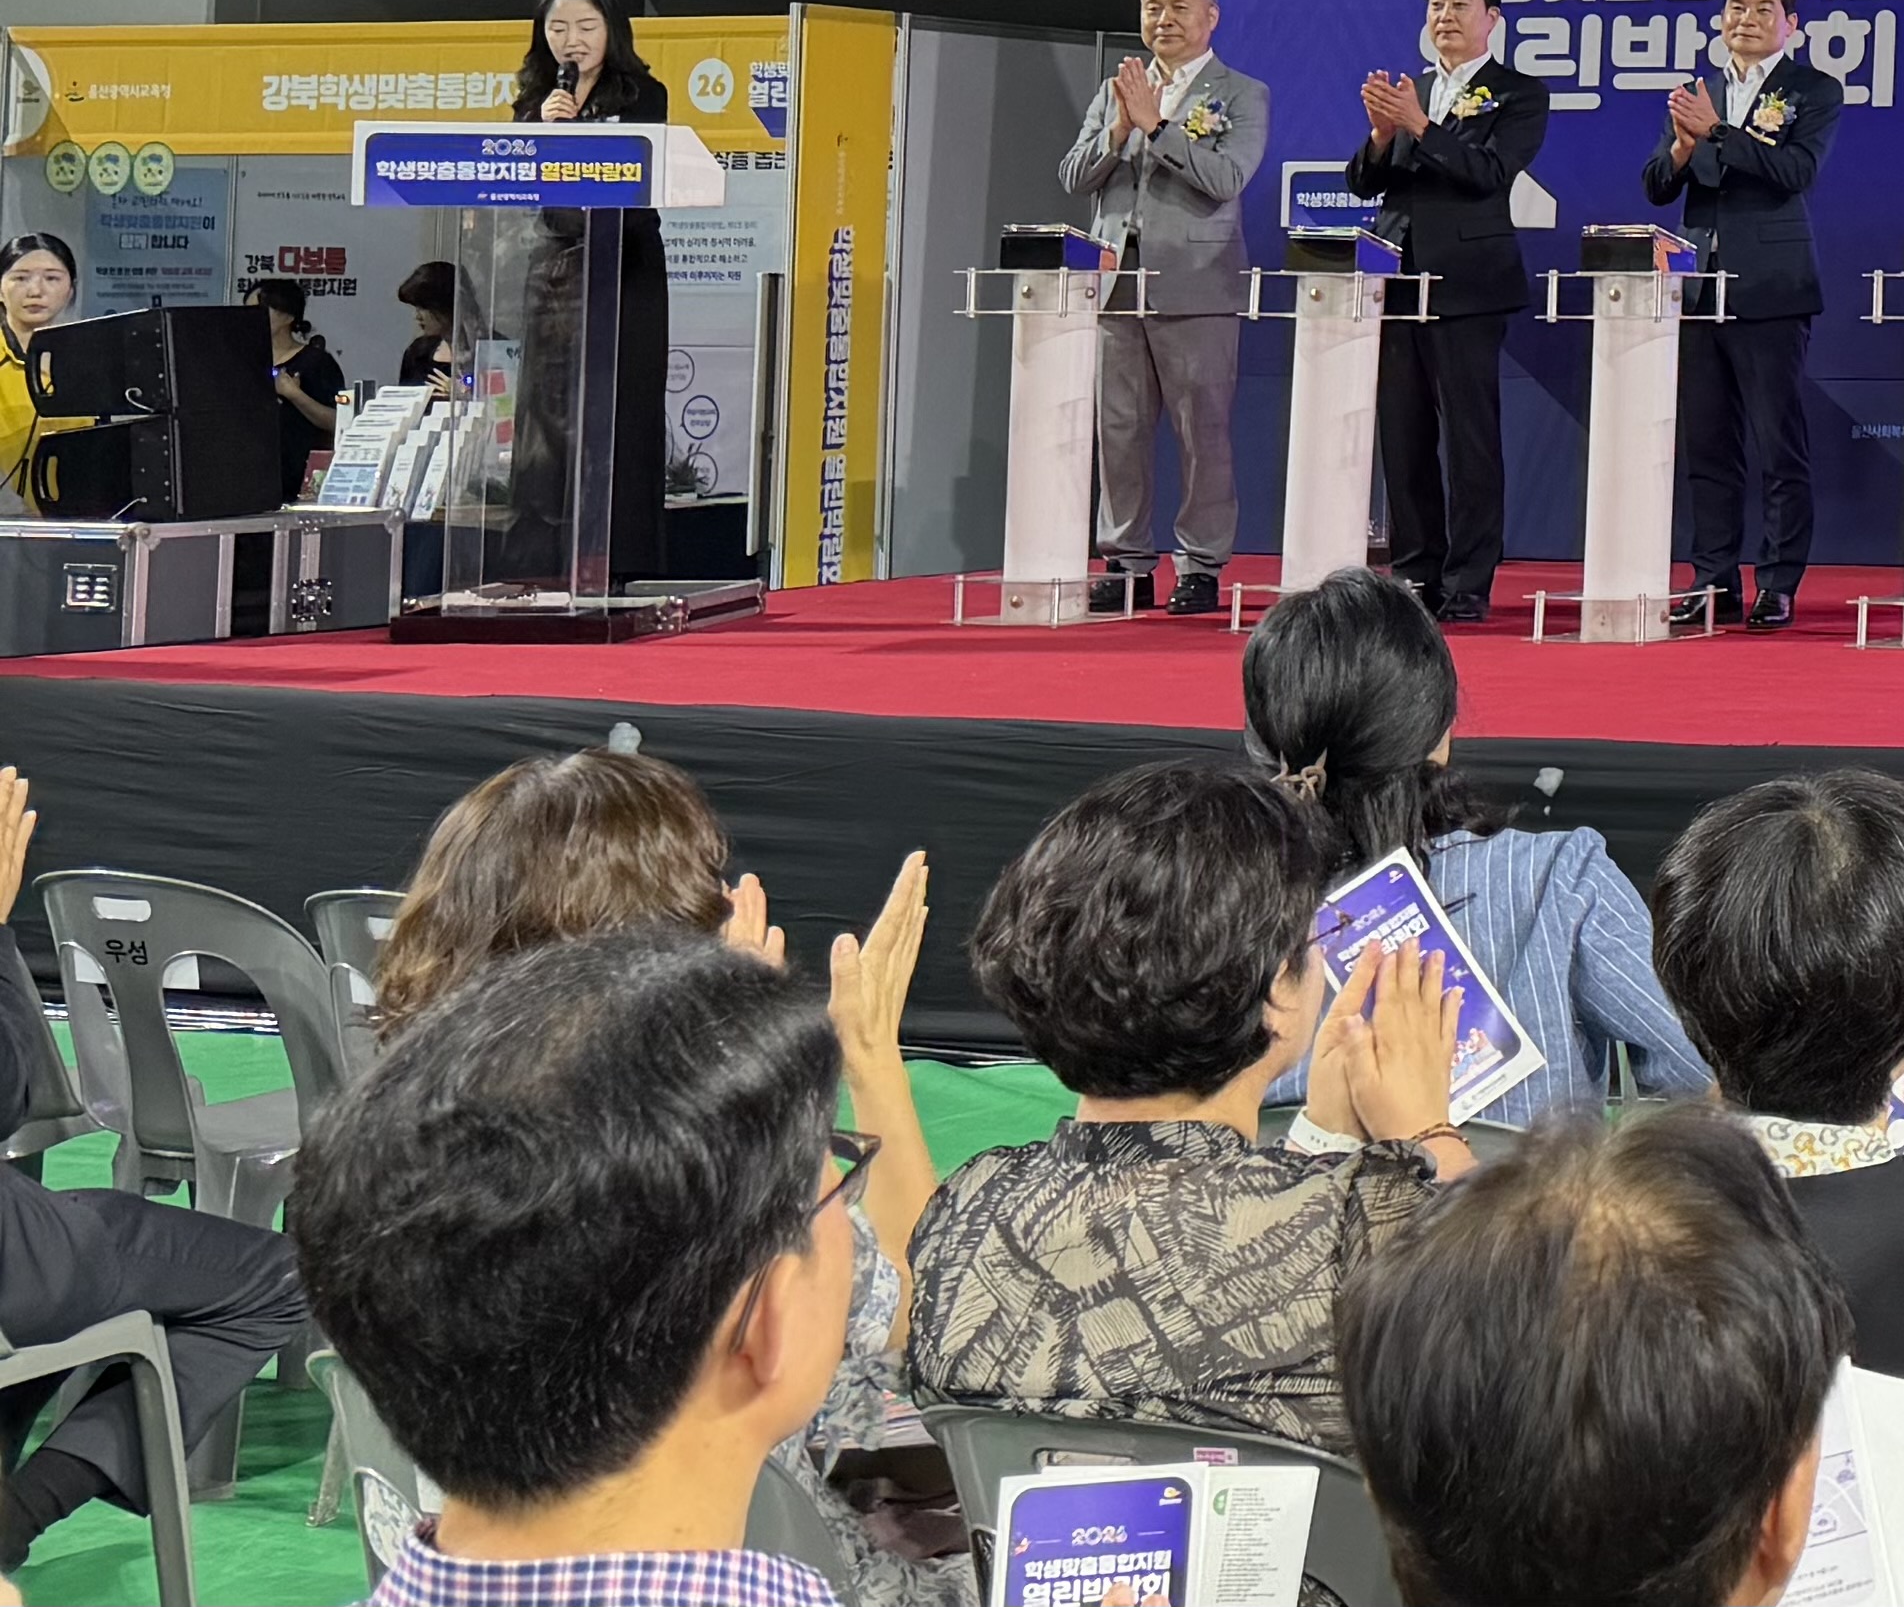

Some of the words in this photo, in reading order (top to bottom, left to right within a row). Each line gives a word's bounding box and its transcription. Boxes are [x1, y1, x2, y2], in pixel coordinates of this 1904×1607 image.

[1420, 9, 1897, 110] 린박회
[696, 74, 726, 97] 26
[481, 138, 537, 157] 2026
[375, 160, 537, 182] 학생맞춤통합지원
[540, 161, 642, 182] 열린박람회
[244, 254, 275, 274] 강북
[105, 939, 149, 965] 우성
[1071, 1524, 1129, 1547] 2026
[1024, 1548, 1173, 1582] 학생맞춤통합지원
